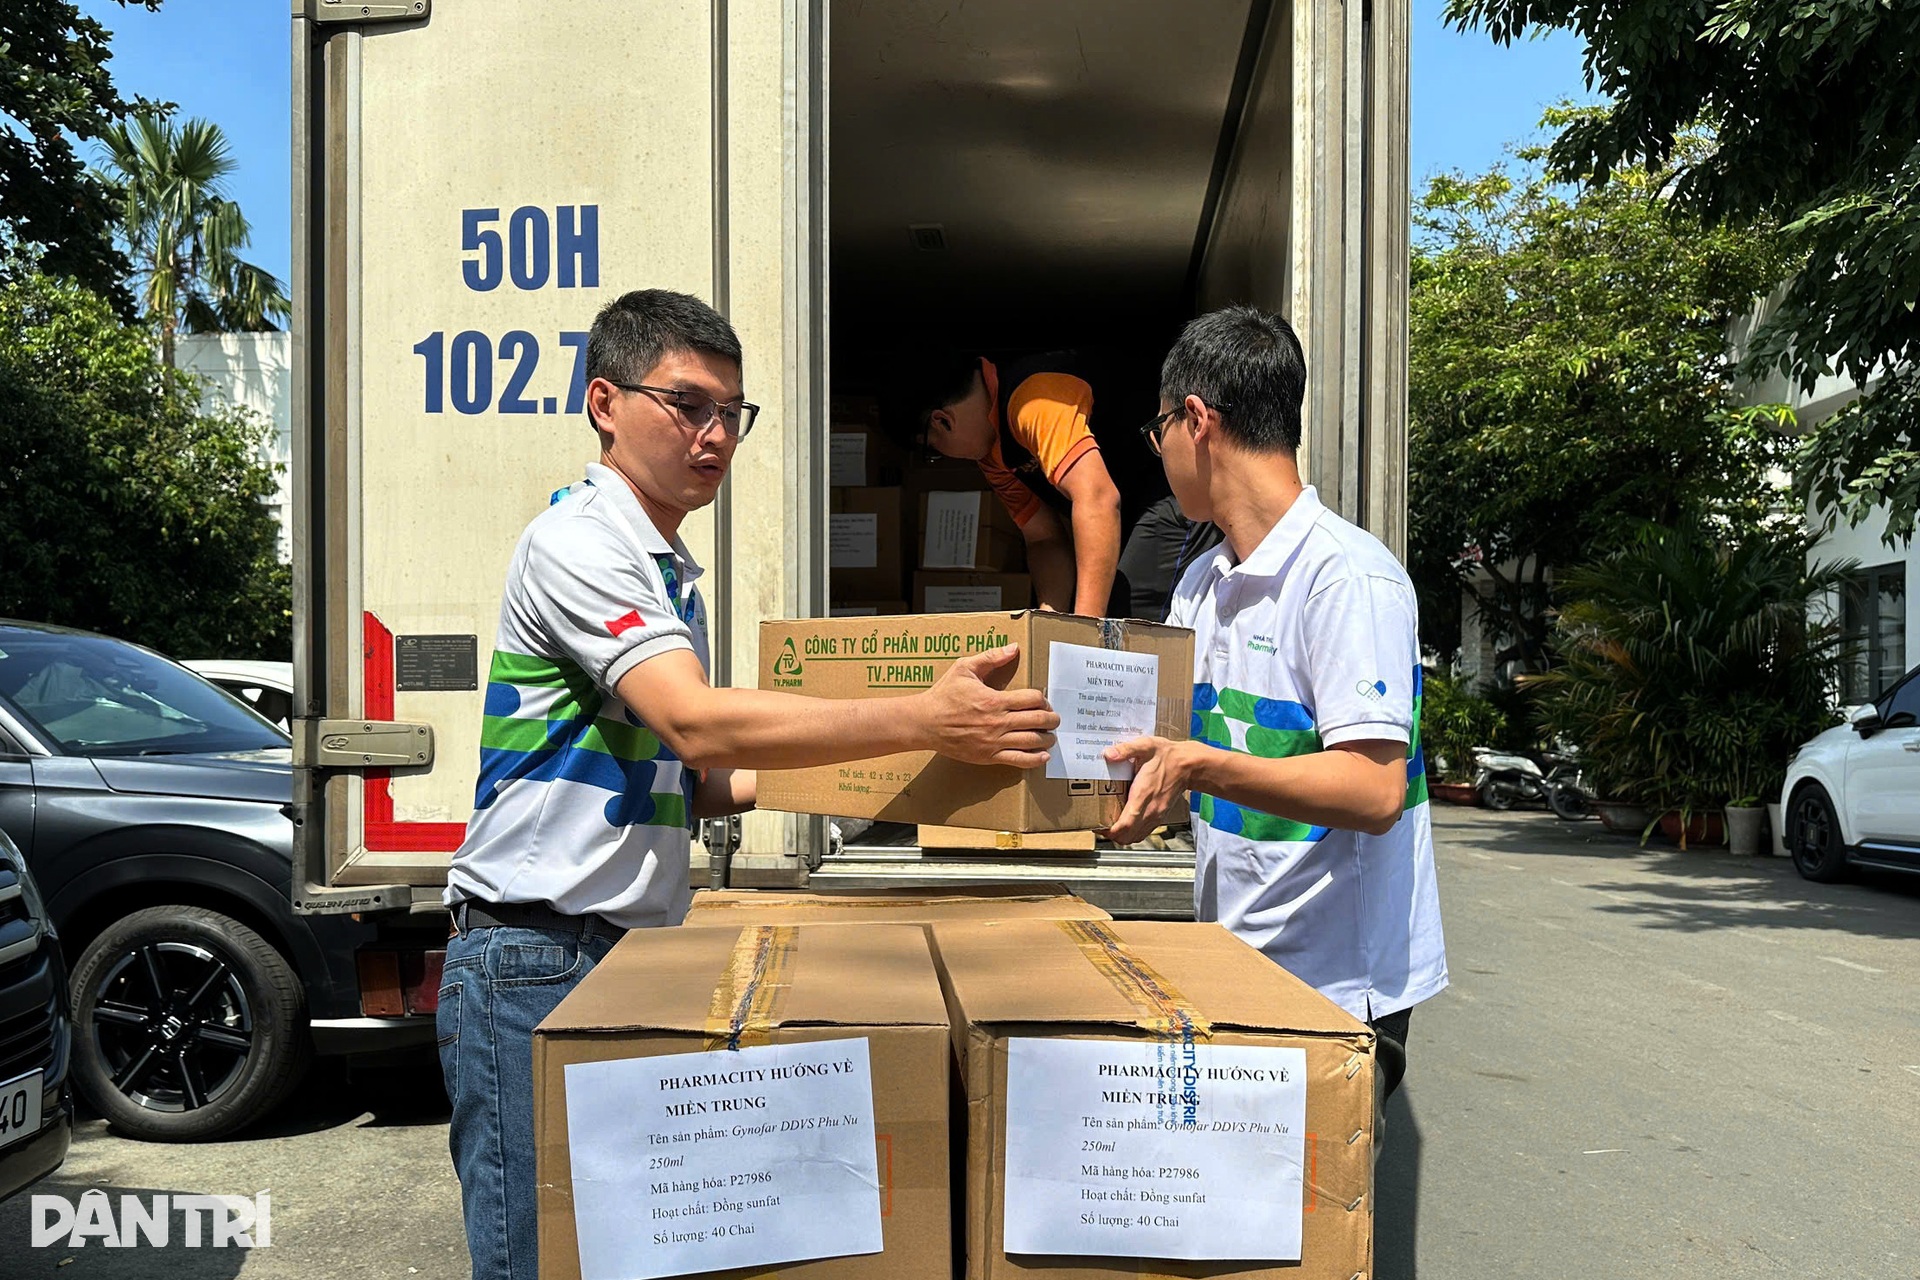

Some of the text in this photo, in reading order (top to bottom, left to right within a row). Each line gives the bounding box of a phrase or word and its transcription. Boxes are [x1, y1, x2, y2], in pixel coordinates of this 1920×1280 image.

[462, 204, 599, 291] 50H
[805, 626, 1008, 657] CÔNG TY CỔ PHẦN DƯỢC PHẨM
[867, 665, 934, 682] TV.PHARM
[773, 678, 803, 688] TV.PHARM
[660, 1069, 766, 1090] PHARMACITY
[771, 1062, 828, 1080] HƯỚNG
[1098, 1064, 1203, 1079] PHARMACITY
[1207, 1066, 1264, 1081] HƯỚNG
[711, 1096, 766, 1112] TRUNG
[1147, 1093, 1200, 1105] TRUNG
[647, 1114, 858, 1145] Tên sản phẩm: Gynofar DDVS Phu Nu
[1082, 1116, 1289, 1134] Tên sản phẩm: Gynofar DDVS Phu Nu
[1081, 1140, 1116, 1152] 250ml
[649, 1155, 684, 1169] 250ml
[1081, 1165, 1200, 1179] Mã hàng hóa: P27986
[651, 1171, 772, 1195] Mã hàng hóa: P27986
[1081, 1187, 1206, 1205] Hoạt chất: Đồng sunfat
[652, 1195, 780, 1220] Hoạt chất: Đồng sunfat
[1080, 1210, 1179, 1228] Số lượng: 40 Chai
[653, 1222, 755, 1245] Số lượng: 40 Chai
